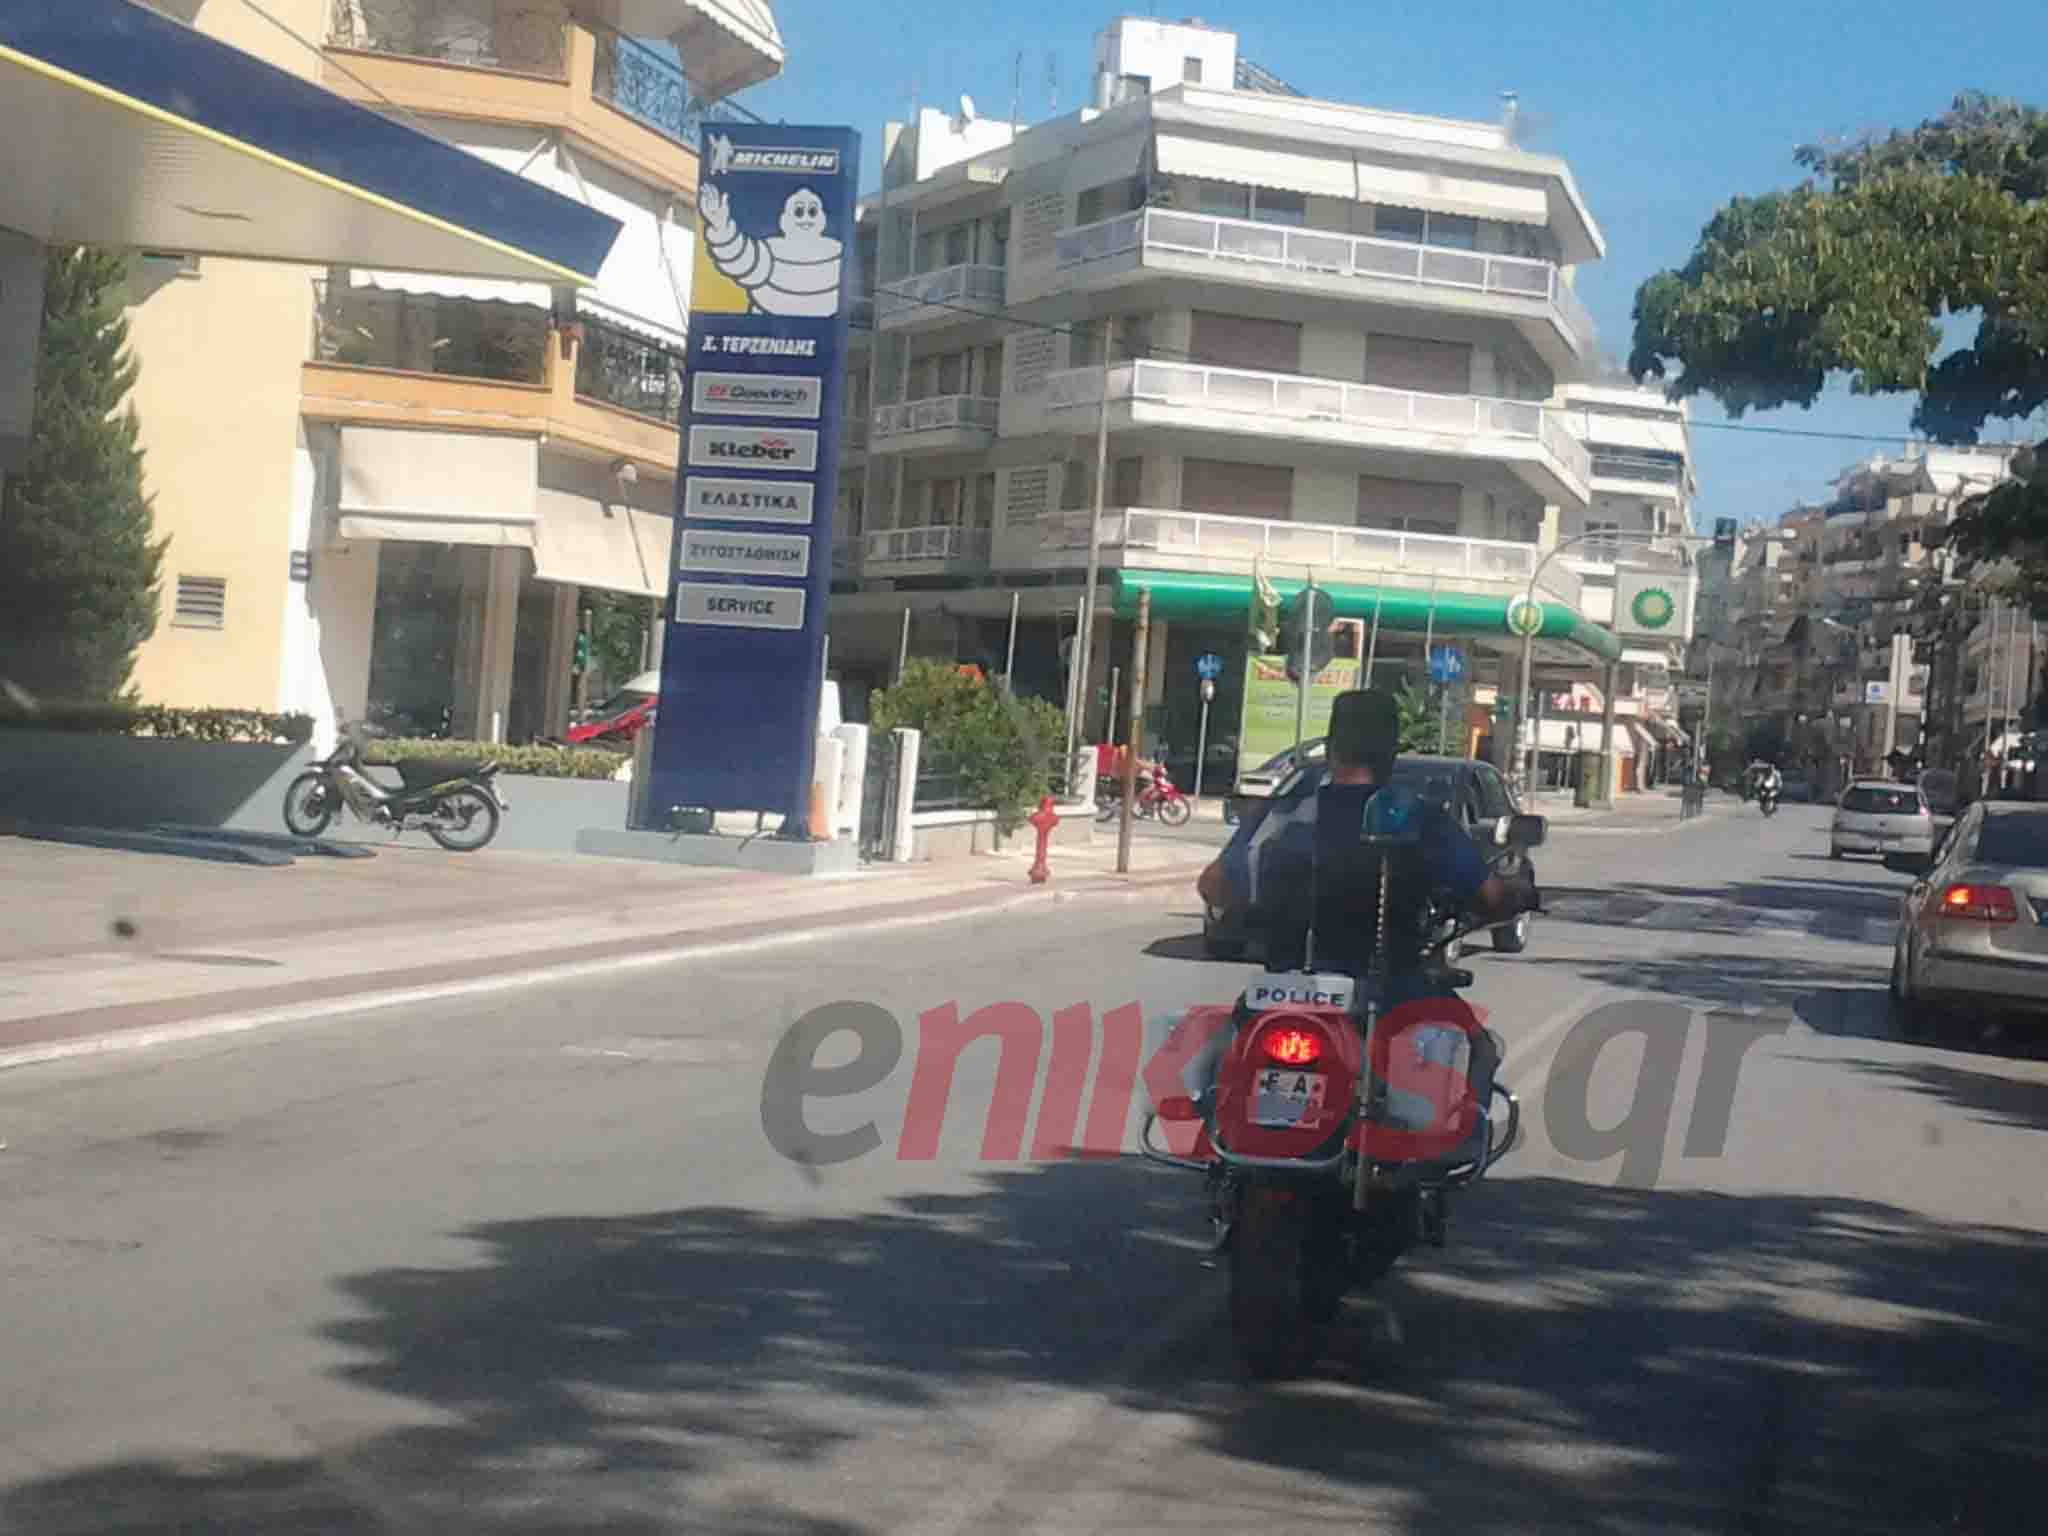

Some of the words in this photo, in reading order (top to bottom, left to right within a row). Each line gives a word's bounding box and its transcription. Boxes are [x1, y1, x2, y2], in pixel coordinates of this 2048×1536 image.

[736, 151, 834, 168] MICHELIN
[708, 440, 796, 459] Kleber
[701, 491, 799, 510] ΕΛΑΣΤΙΚΑ
[706, 597, 777, 615] SERVICE
[1256, 987, 1345, 1008] POLICE
